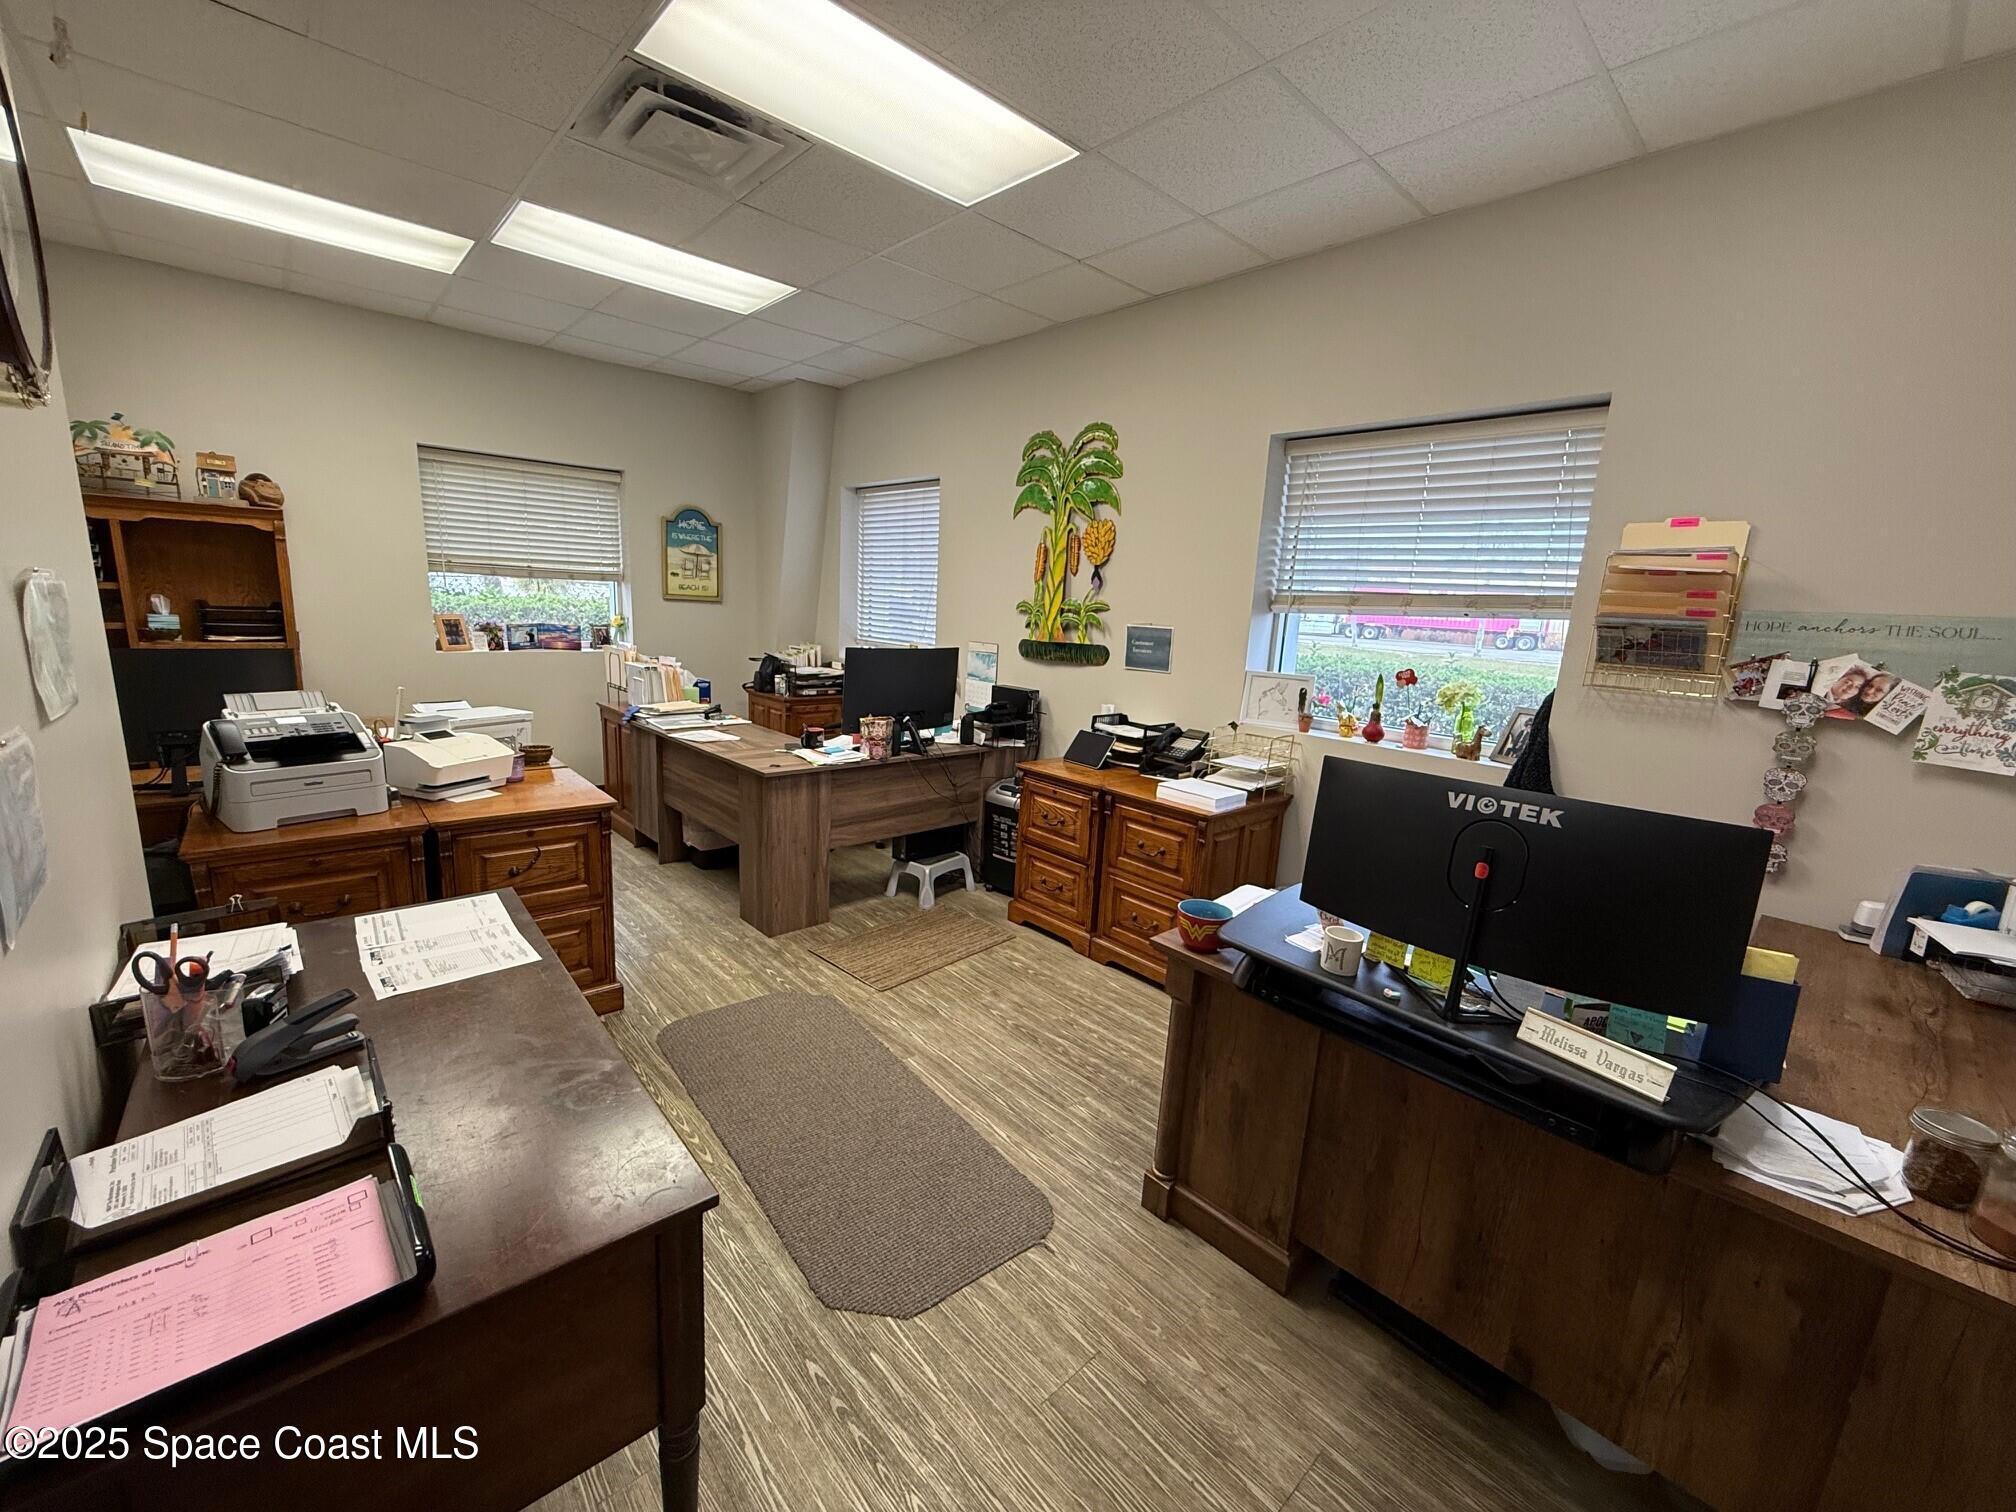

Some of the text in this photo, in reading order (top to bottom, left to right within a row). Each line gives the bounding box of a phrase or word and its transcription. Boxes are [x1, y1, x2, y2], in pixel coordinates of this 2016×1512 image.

[678, 518, 706, 530] HOME
[1745, 620, 1793, 633] HOPE
[1797, 618, 1881, 634] anchors
[1884, 624, 1924, 638] THE
[1932, 719, 2012, 749] everything
[1447, 791, 1566, 829] VIOTEK
[1538, 1024, 1588, 1060] Melissa
[1596, 1048, 1645, 1084] Vargas
